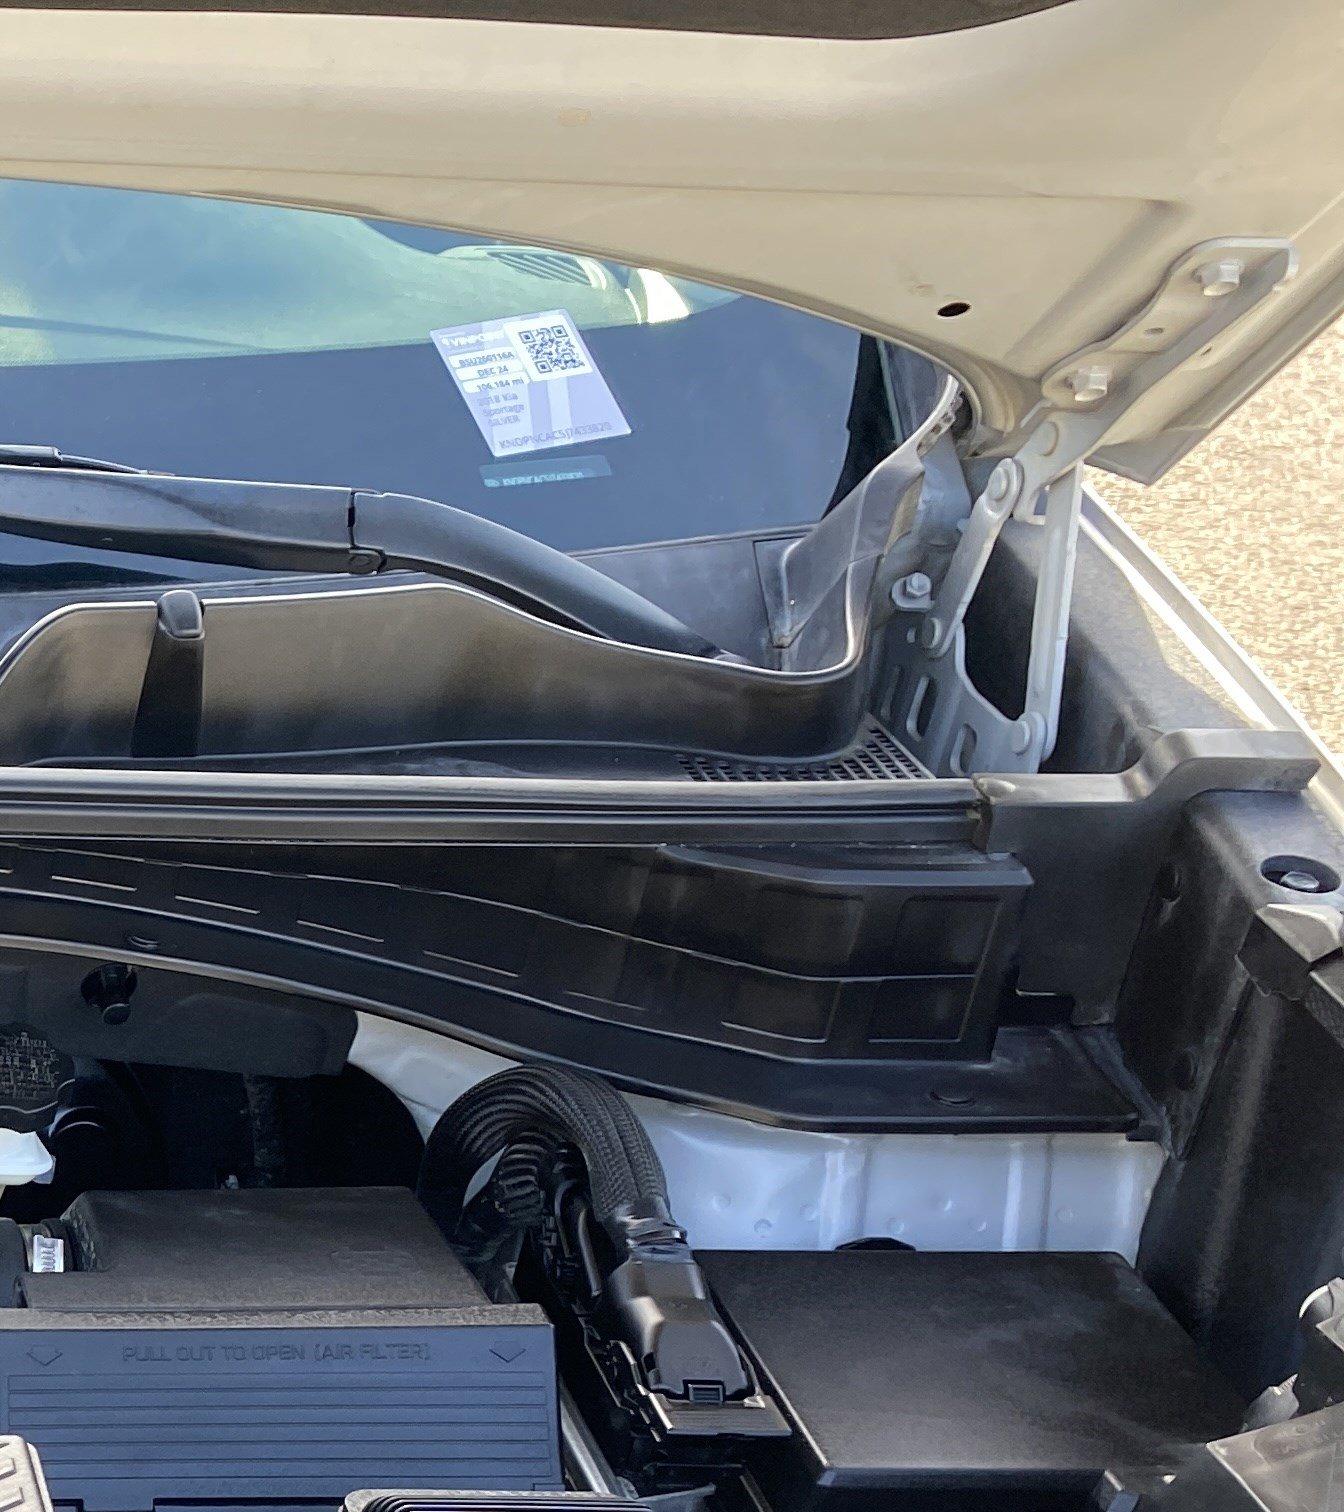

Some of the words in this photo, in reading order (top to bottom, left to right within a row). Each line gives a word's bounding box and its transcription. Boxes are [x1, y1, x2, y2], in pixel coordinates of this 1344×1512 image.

[478, 367, 496, 378] DEC
[498, 365, 509, 373] 24
[122, 1344, 172, 1362] PULL
[177, 1345, 216, 1362] OUT
[221, 1345, 246, 1361] TO
[252, 1344, 305, 1362] OPEN
